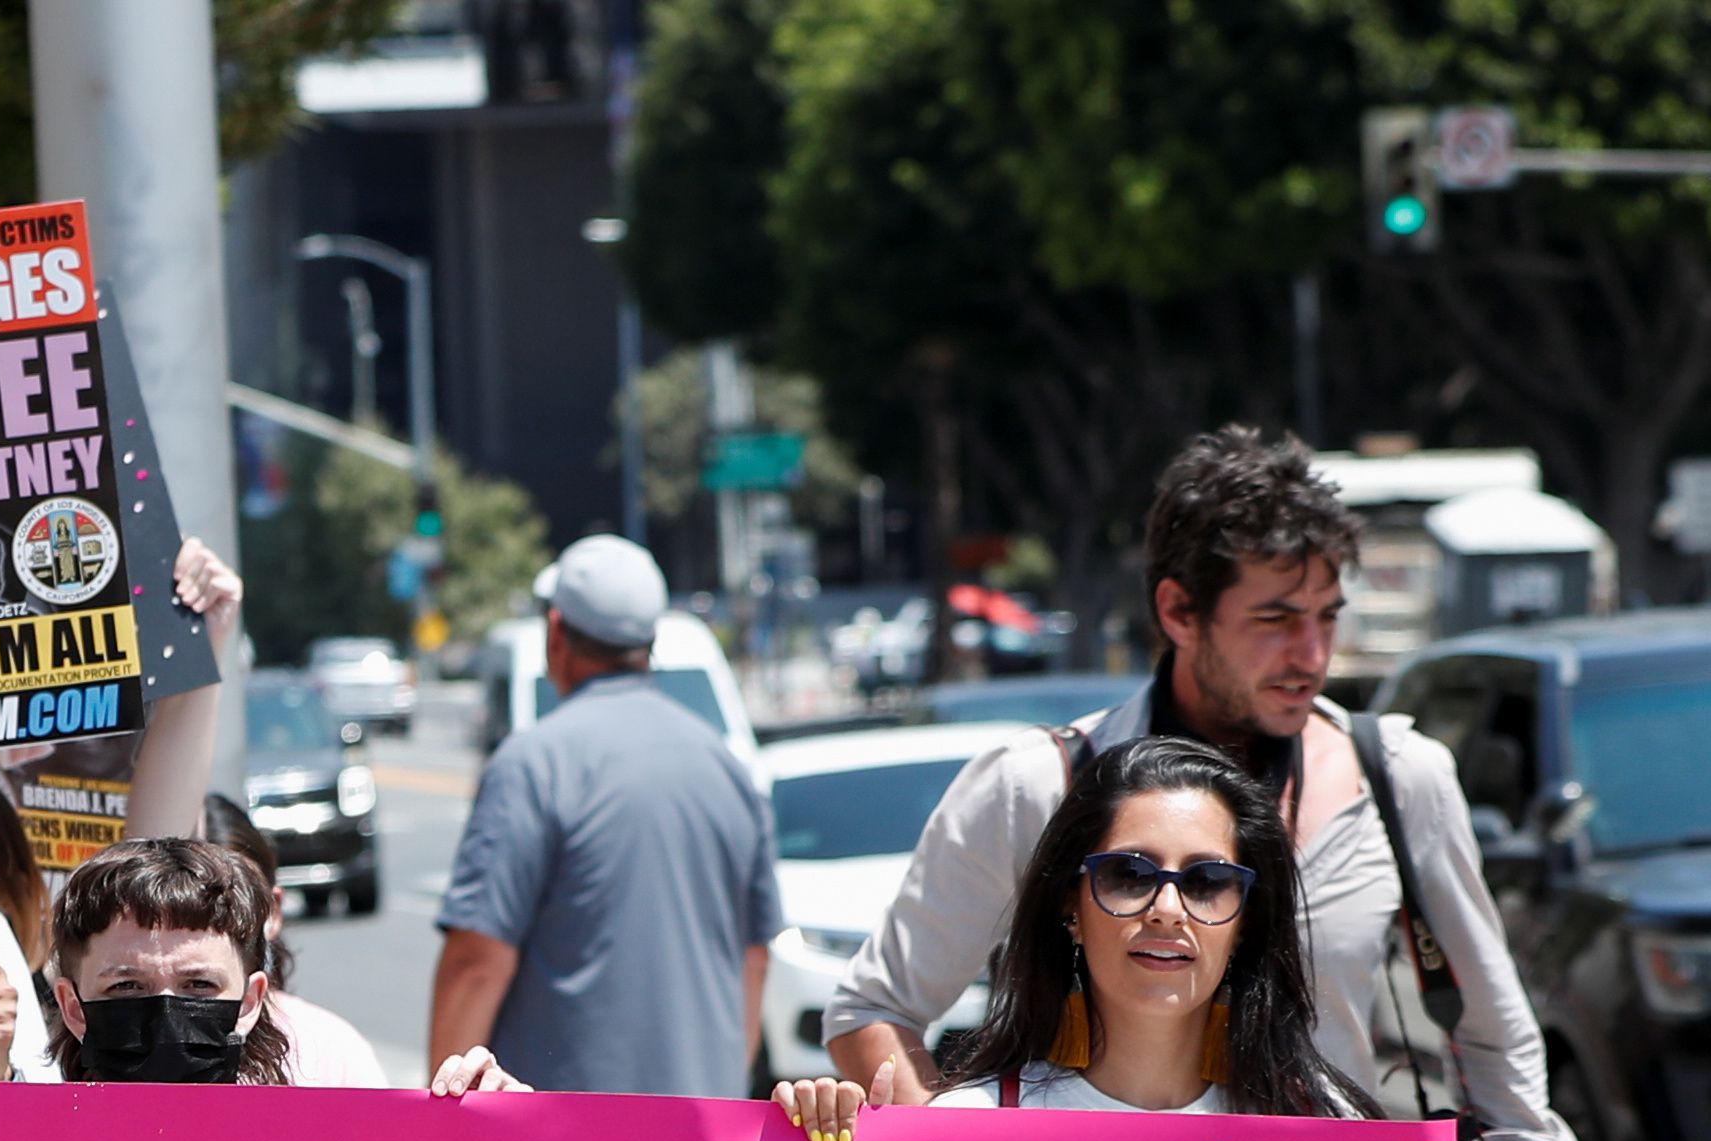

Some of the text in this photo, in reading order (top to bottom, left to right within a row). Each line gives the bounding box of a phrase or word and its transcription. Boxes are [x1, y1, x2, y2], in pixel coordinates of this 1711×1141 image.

[52, 613, 126, 667] ALL
[82, 663, 120, 679] PROVE
[121, 662, 132, 674] IT
[22, 784, 89, 812] BRENDA
